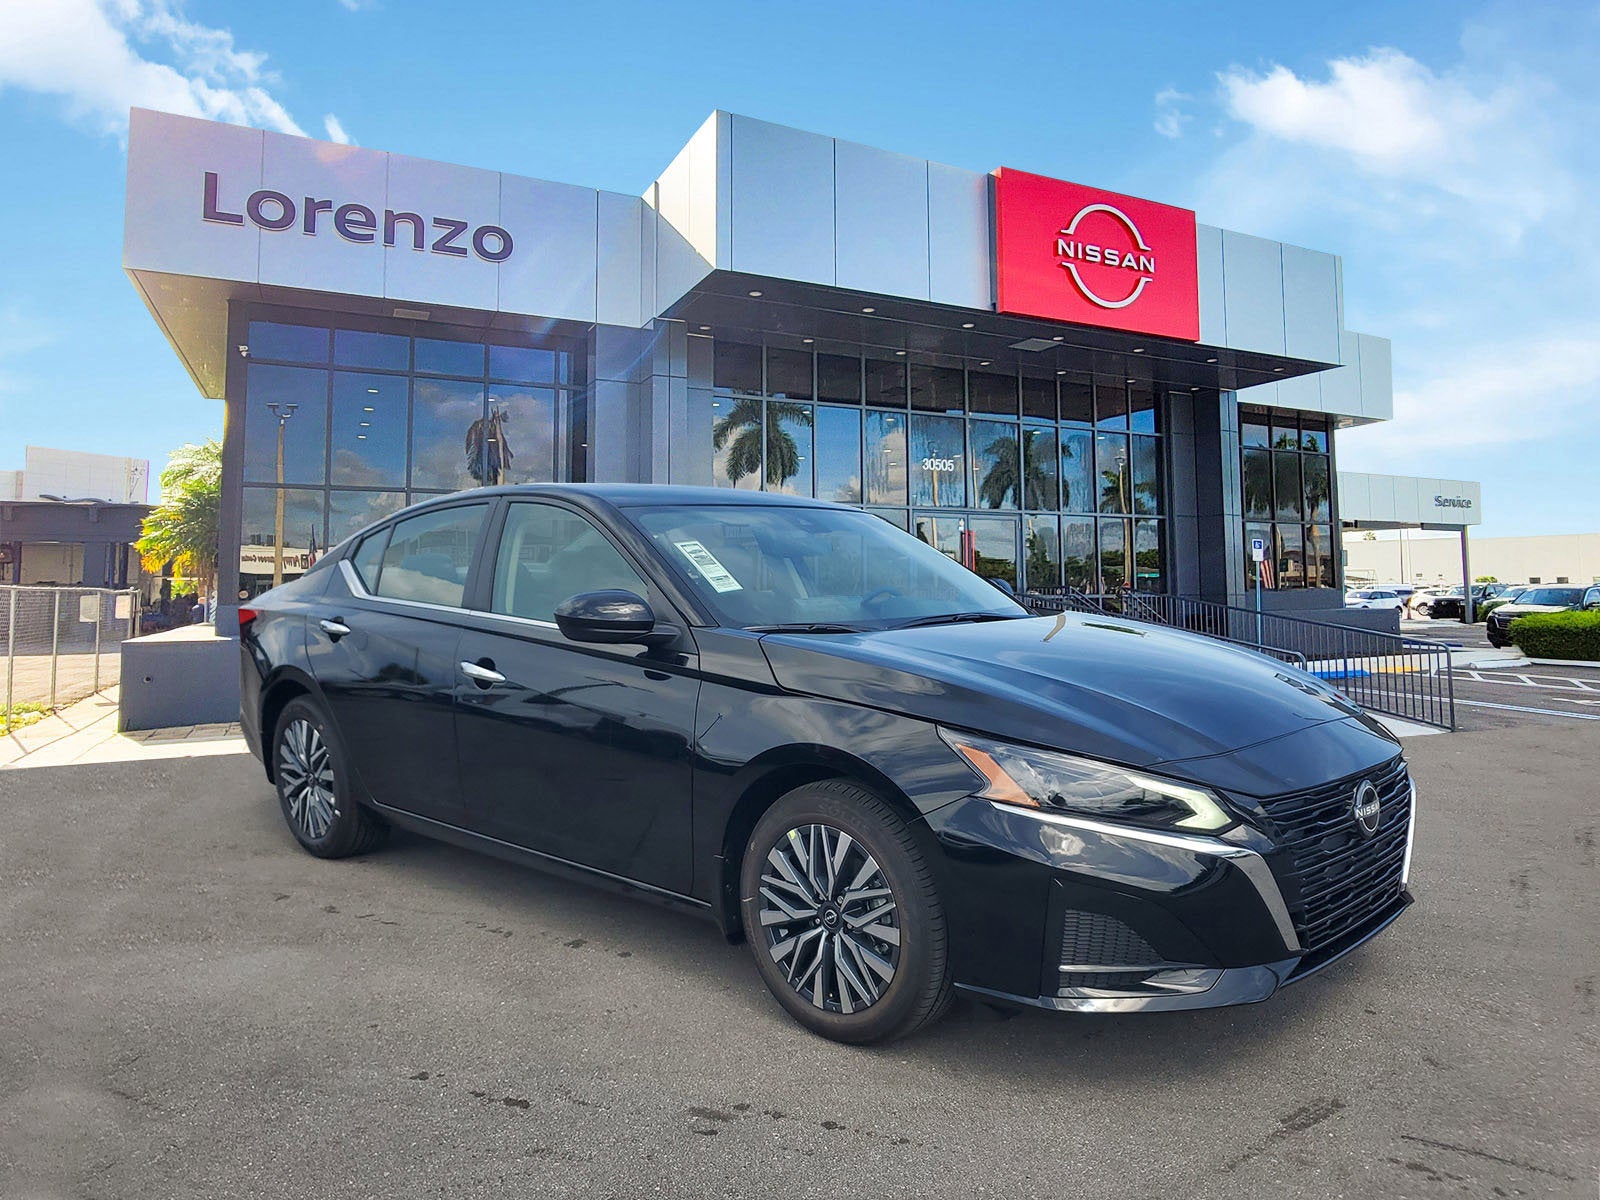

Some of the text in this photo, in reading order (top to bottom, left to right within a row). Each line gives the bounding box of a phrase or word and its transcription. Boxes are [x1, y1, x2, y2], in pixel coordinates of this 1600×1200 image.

[202, 171, 514, 262] Lorenzo
[1057, 238, 1155, 273] NISSAN
[922, 457, 955, 471] 30505
[1434, 495, 1472, 508] Service
